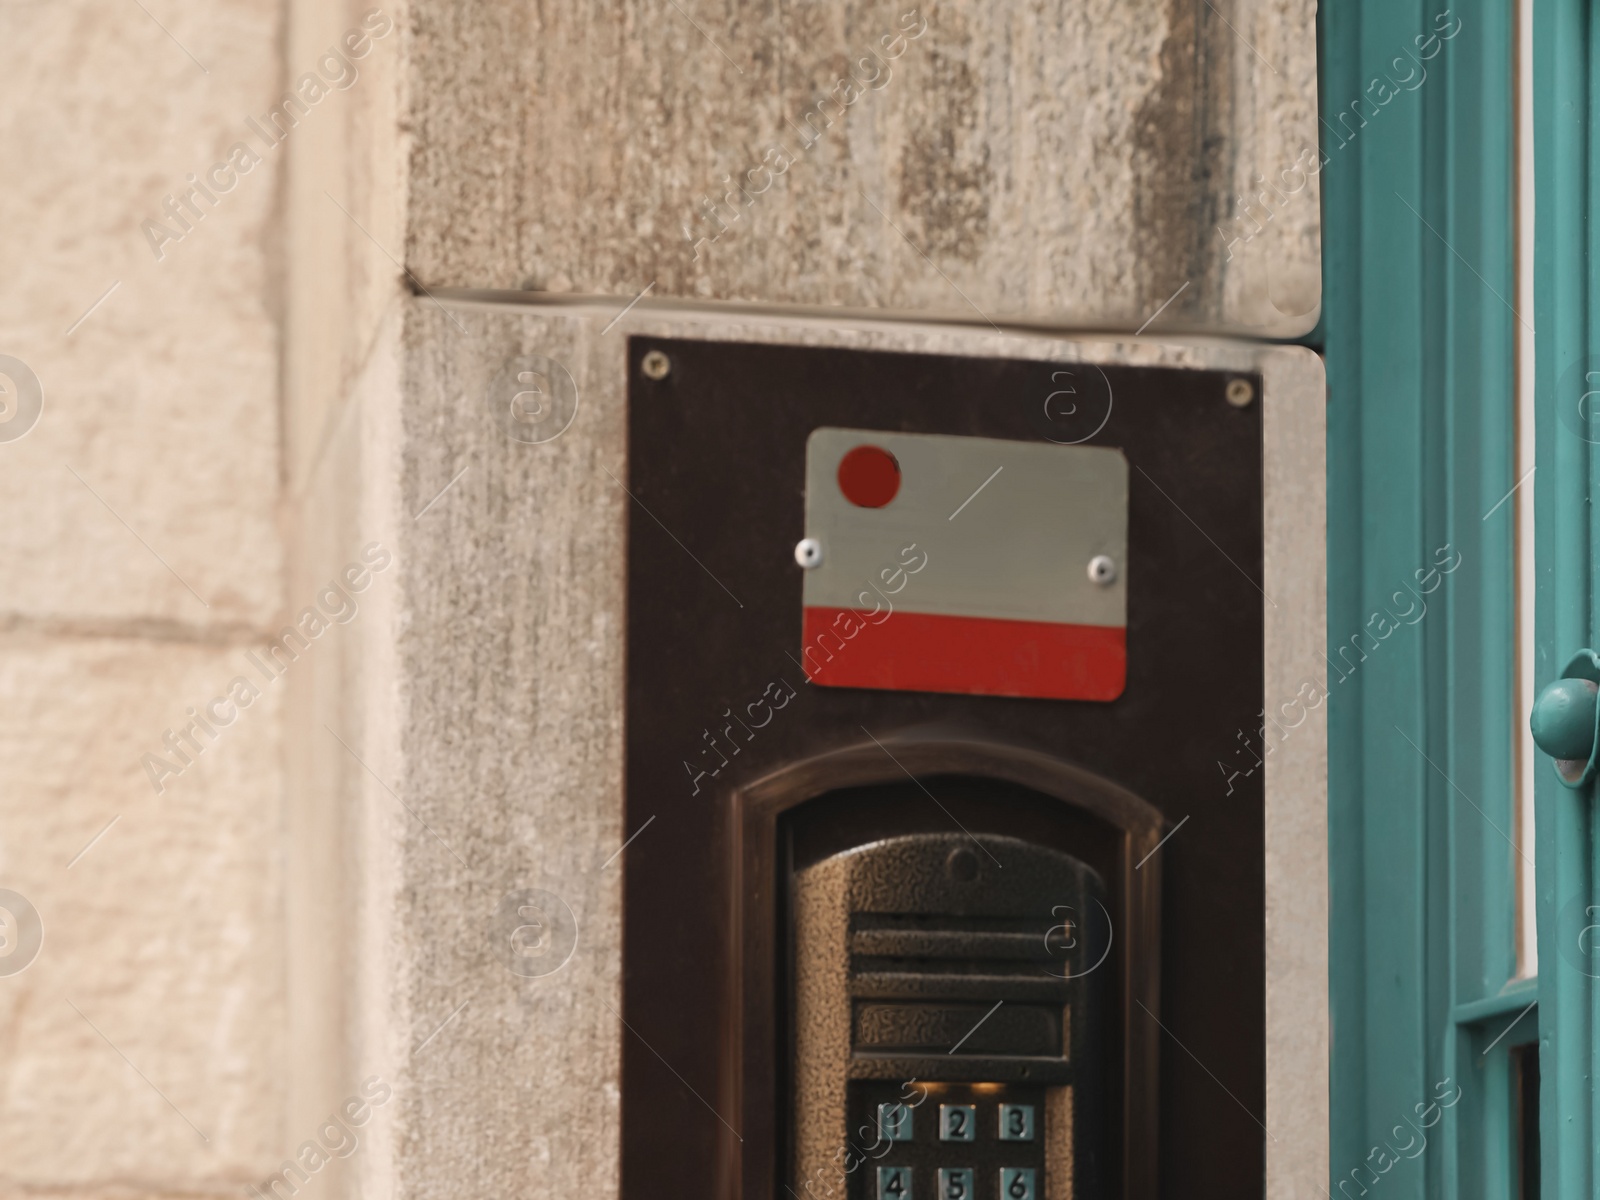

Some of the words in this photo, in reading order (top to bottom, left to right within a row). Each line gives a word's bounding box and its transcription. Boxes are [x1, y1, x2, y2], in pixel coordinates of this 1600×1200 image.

[890, 1110, 900, 1138] 1
[948, 1108, 967, 1137] 2
[1009, 1108, 1025, 1136] 3
[886, 1171, 905, 1199] 4
[948, 1171, 965, 1200] 5
[1009, 1171, 1027, 1199] 6
